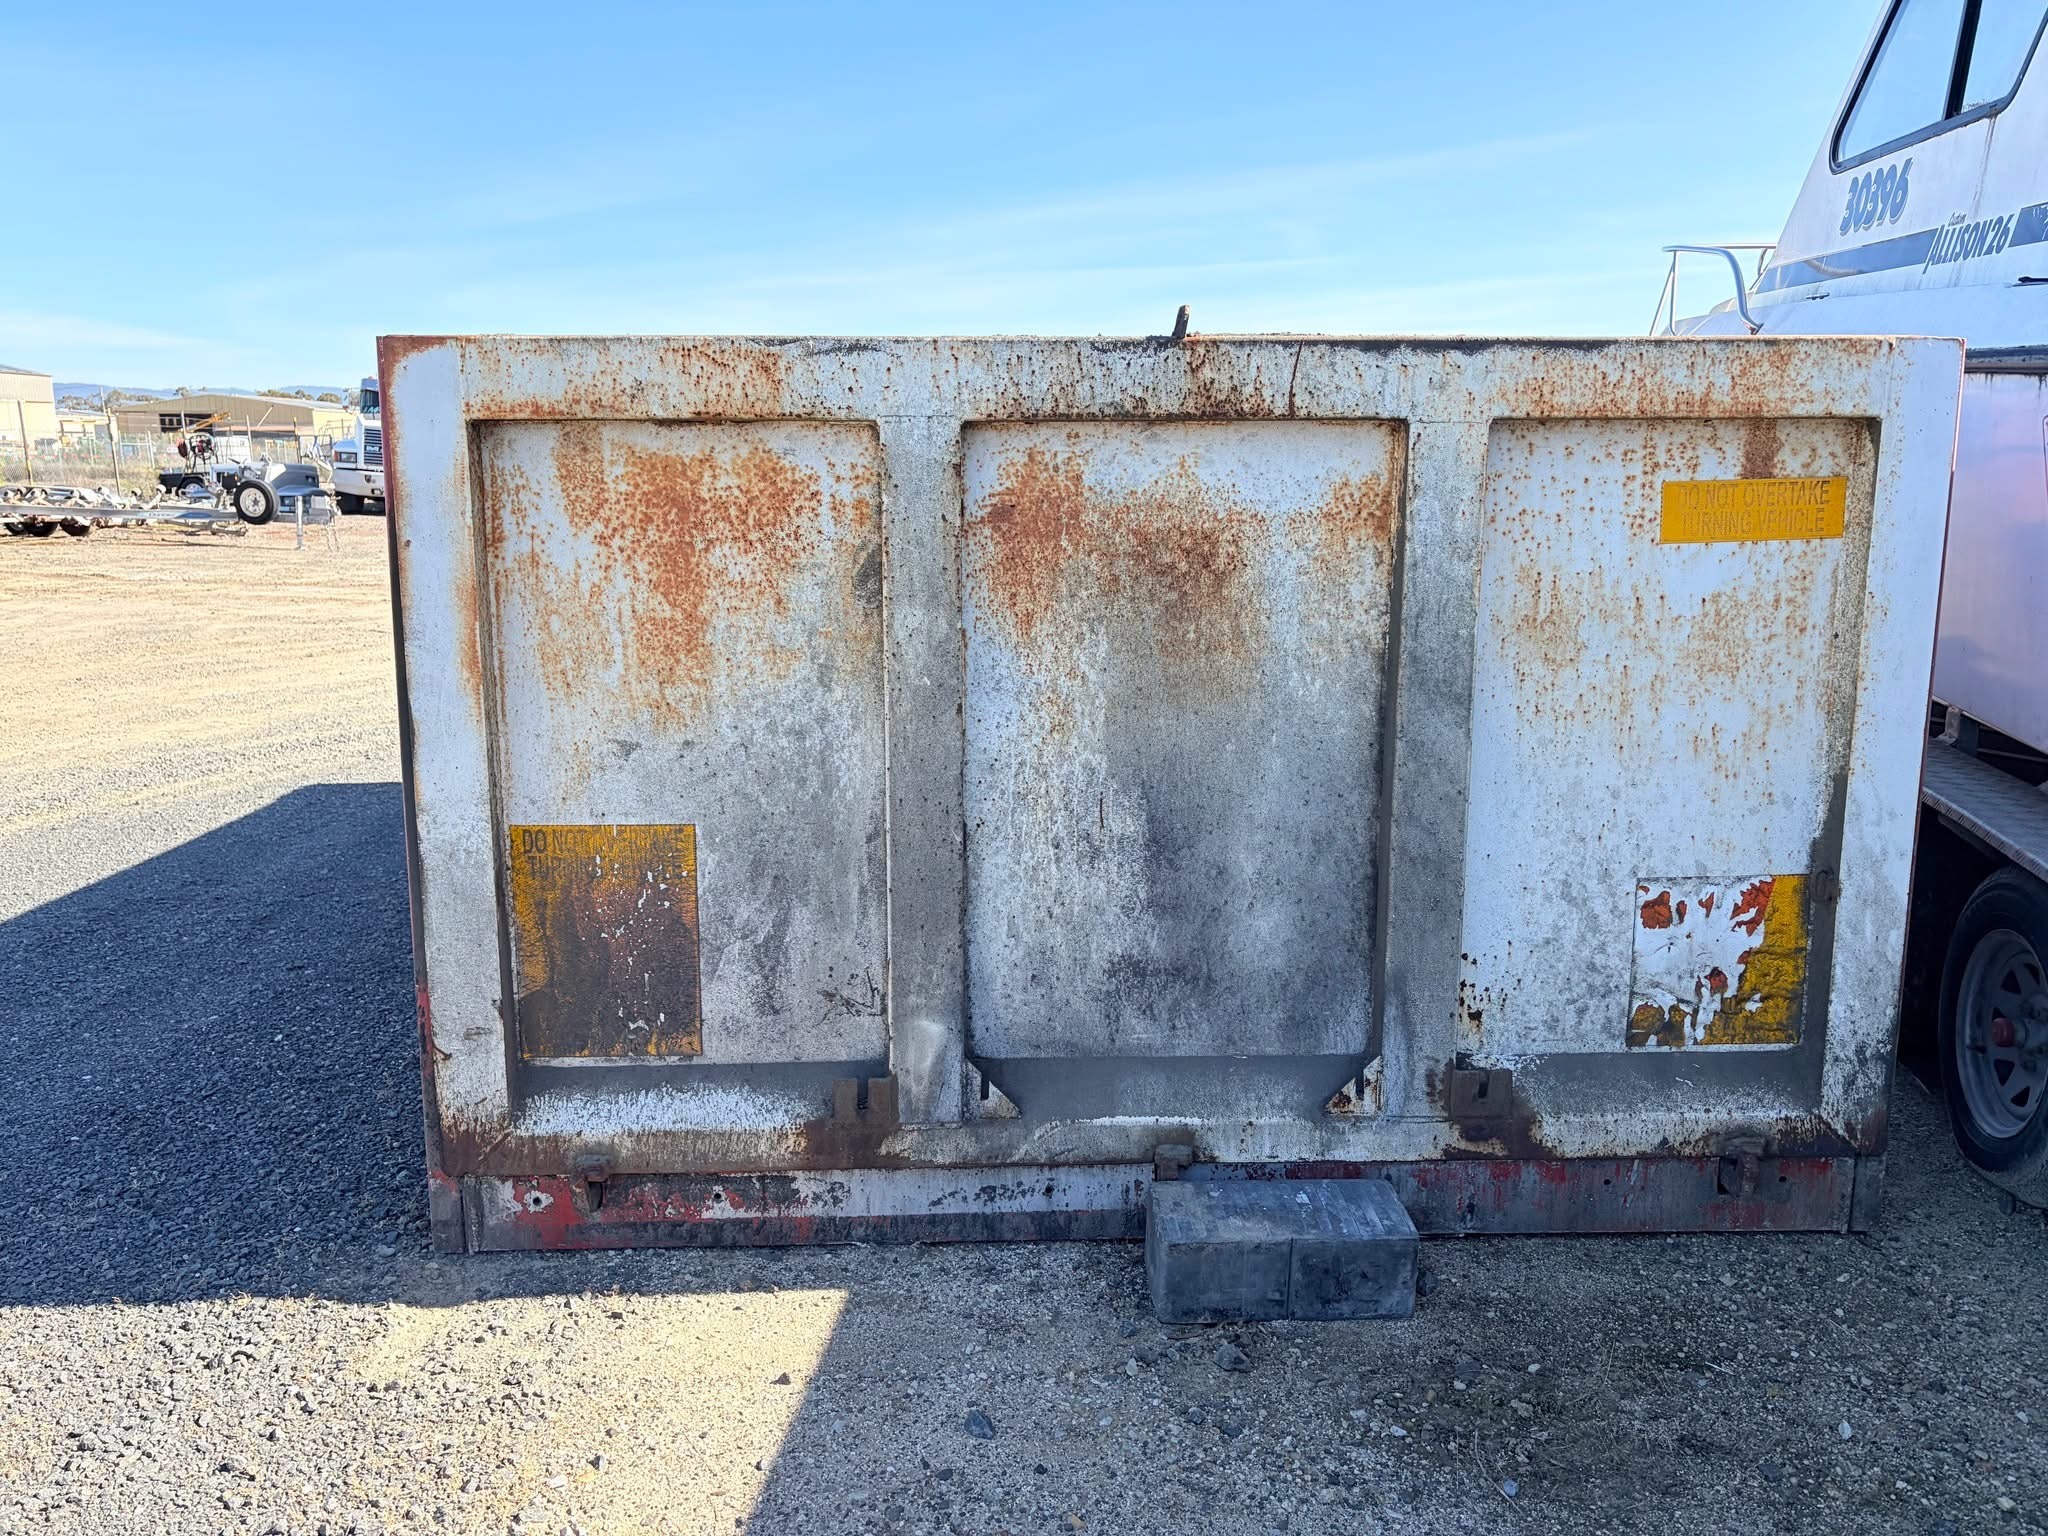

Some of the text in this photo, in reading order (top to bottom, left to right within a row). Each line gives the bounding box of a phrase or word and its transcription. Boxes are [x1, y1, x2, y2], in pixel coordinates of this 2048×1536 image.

[1839, 157, 1913, 237] 30396
[1704, 483, 1740, 509] NOT
[1743, 480, 1831, 508] OVERTAKE
[1682, 507, 1826, 537] TURNING VEHICLE
[522, 829, 547, 854] DO
